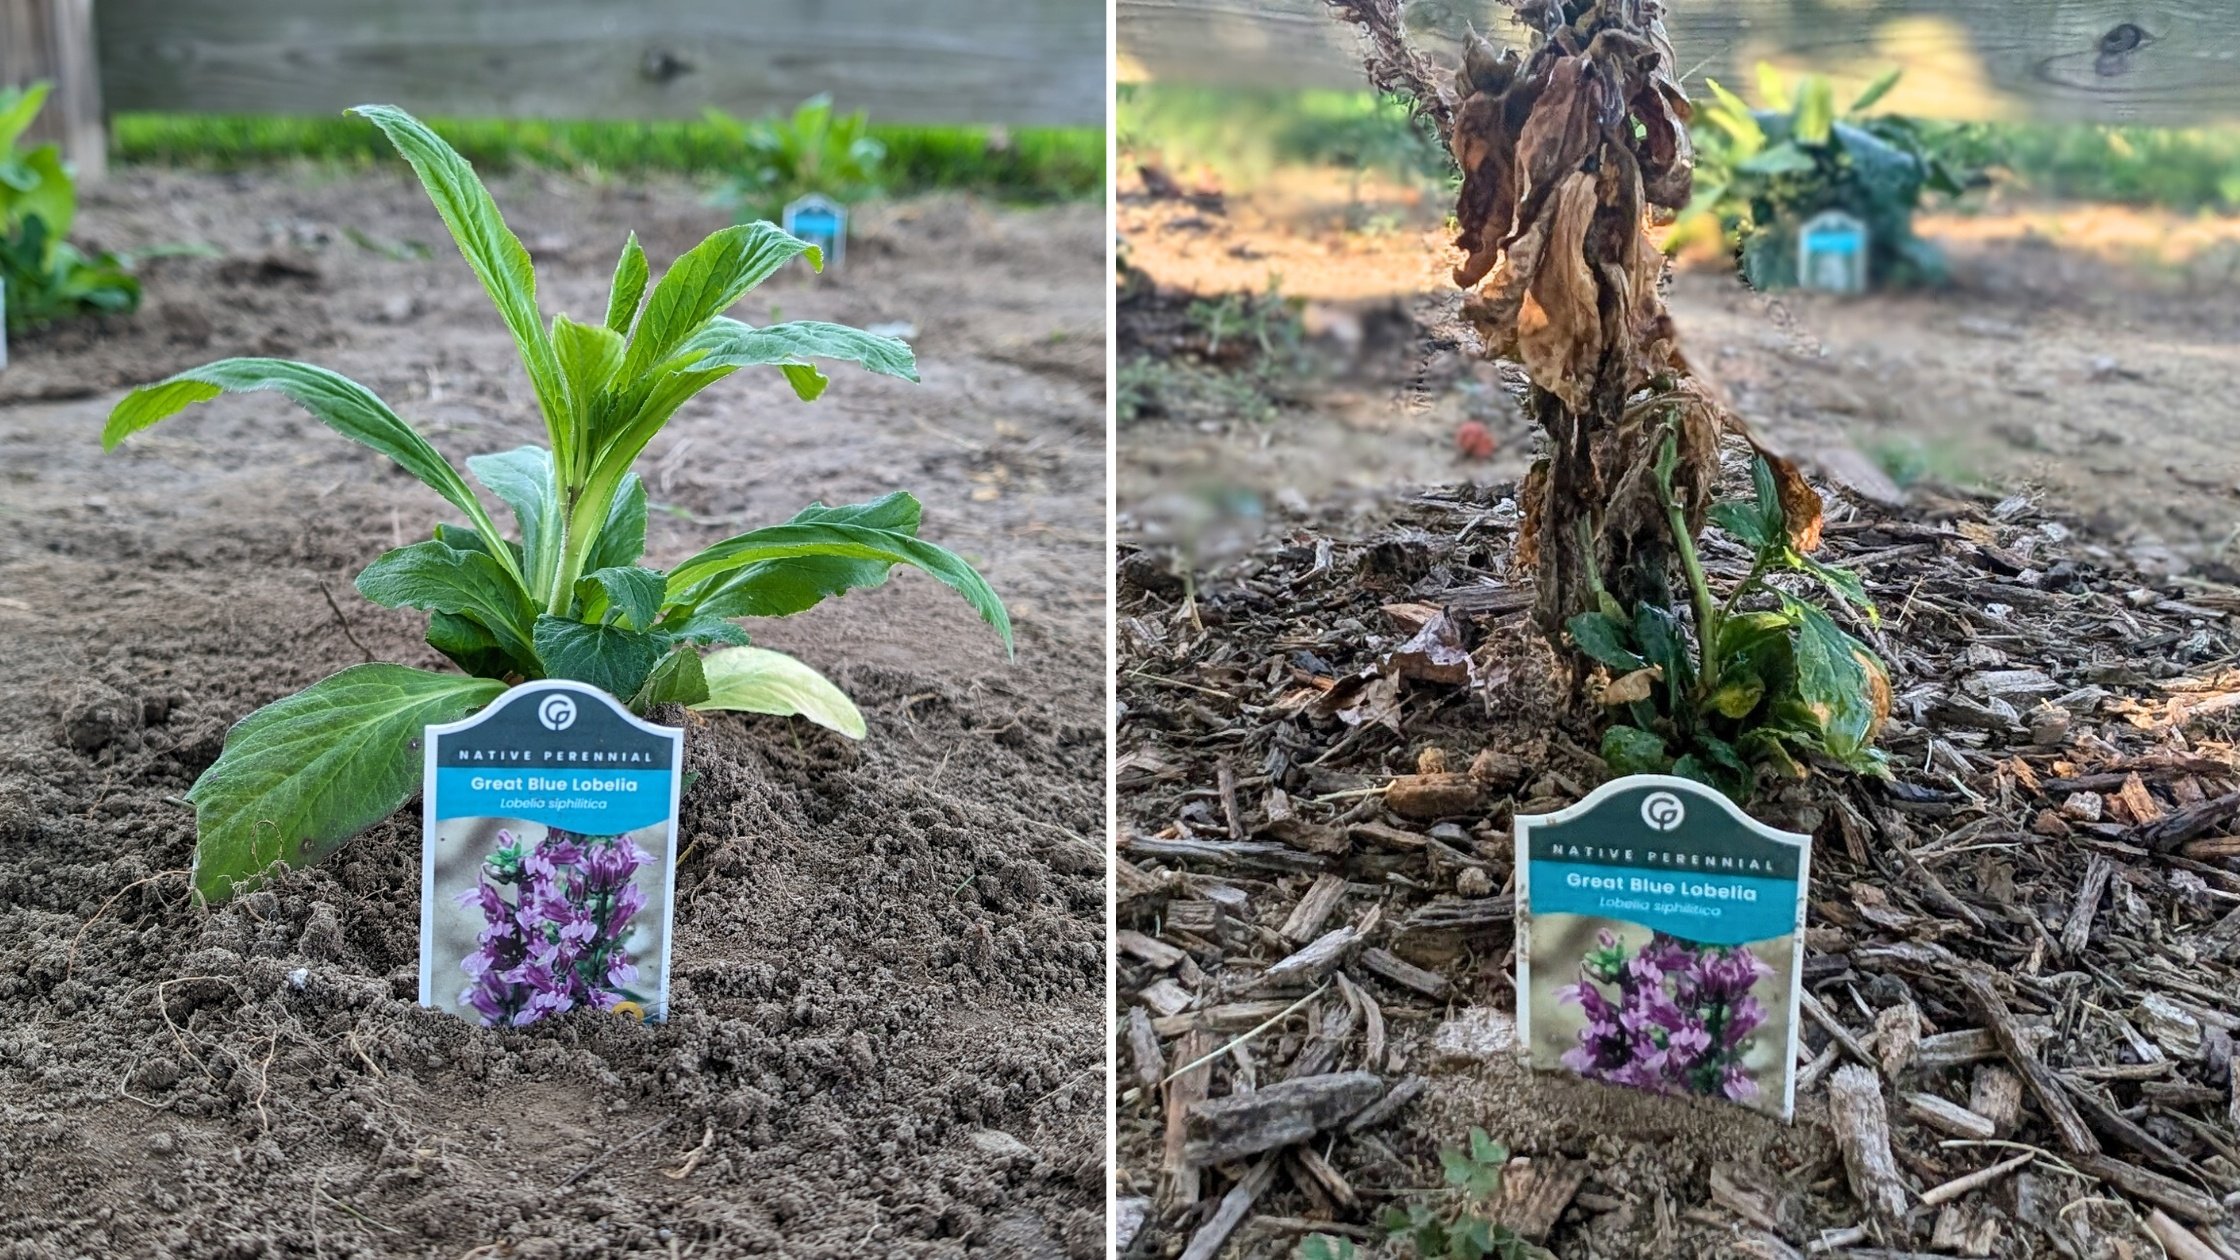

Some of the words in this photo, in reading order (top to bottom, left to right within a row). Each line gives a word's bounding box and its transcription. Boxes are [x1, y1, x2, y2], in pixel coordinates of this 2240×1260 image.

[459, 750, 531, 761] NATIVE
[544, 751, 652, 763] PERENNIAL
[471, 776, 523, 791] Great
[527, 777, 568, 791] Blue
[572, 777, 638, 792] Lobelia
[500, 797, 545, 809] Lobelia
[548, 798, 608, 812] siphilitica
[1552, 843, 1633, 861] NATIVE
[1648, 851, 1774, 872] PERENNIAL
[1566, 872, 1624, 890] Great
[1630, 877, 1675, 895] Blue
[1681, 881, 1758, 902] Lobelia
[1599, 897, 1650, 911] Lobelia
[1653, 901, 1722, 917] siphilitica
